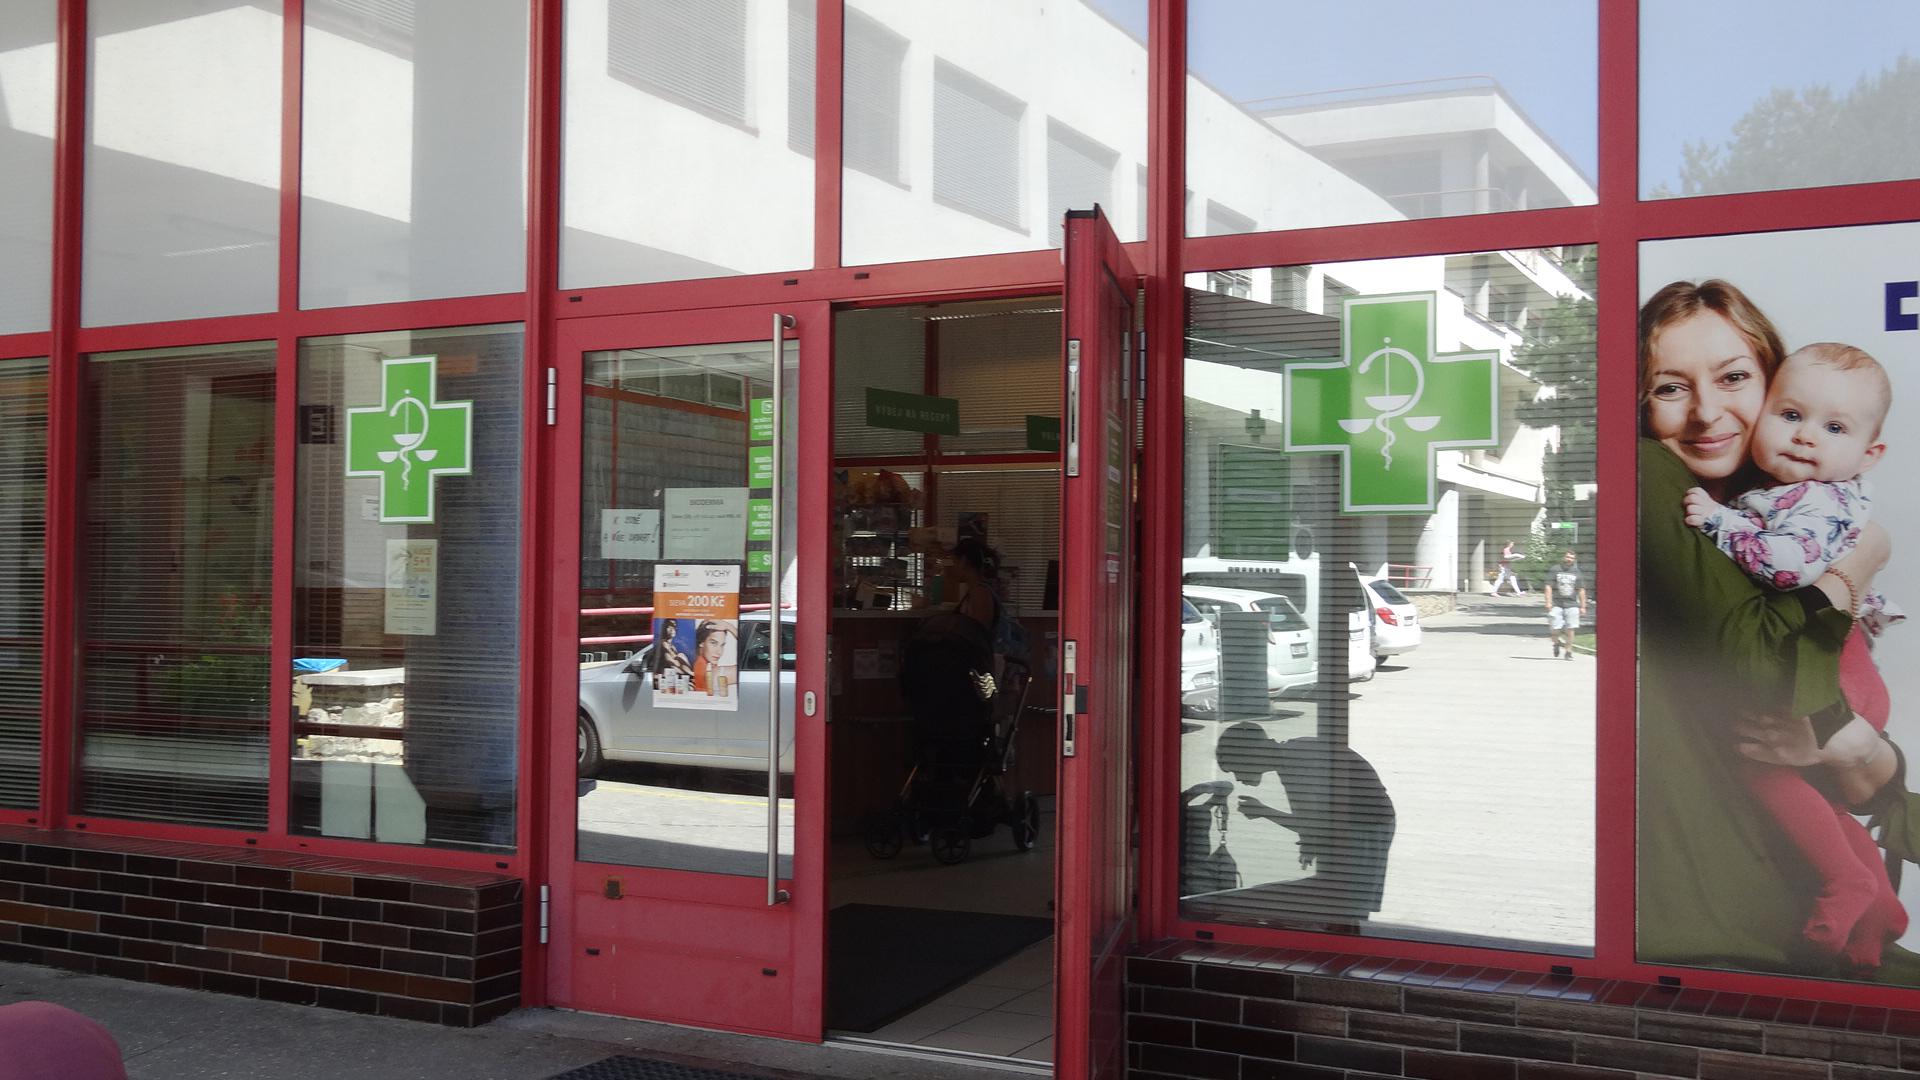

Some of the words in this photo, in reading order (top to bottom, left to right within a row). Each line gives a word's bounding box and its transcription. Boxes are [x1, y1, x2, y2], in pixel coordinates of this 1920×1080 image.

[704, 569, 731, 578] VICHY
[687, 595, 709, 607] 200
[710, 594, 725, 607] Kč
